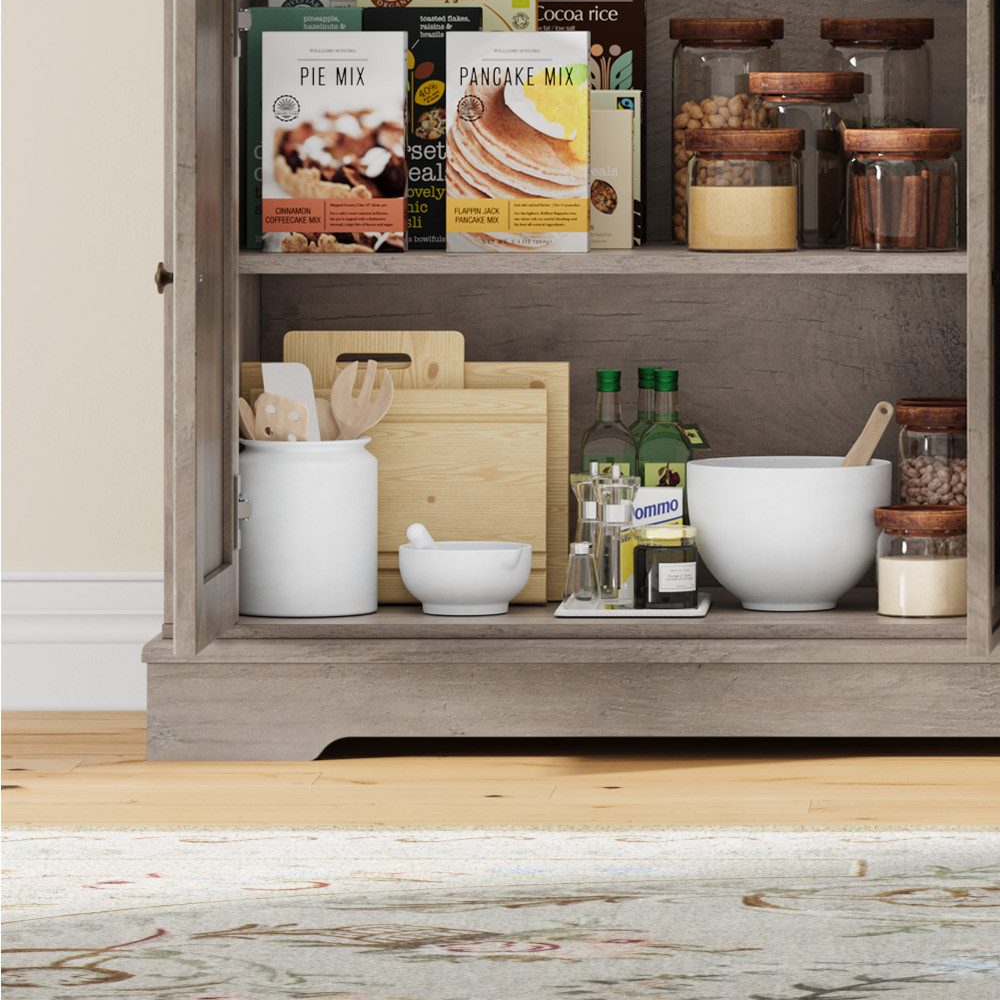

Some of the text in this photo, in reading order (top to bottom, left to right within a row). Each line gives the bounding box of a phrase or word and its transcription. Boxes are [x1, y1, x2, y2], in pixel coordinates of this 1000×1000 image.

[588, 5, 619, 21] rice
[300, 67, 365, 86] PIE MIX
[460, 67, 574, 86] PANCAKE MIX
[408, 163, 446, 182] eal
[275, 206, 311, 214] CINNAMON
[454, 207, 500, 215] FLAPPIN JACK
[265, 216, 307, 224] COFFEECAKE
[308, 216, 321, 224] MIX
[455, 216, 499, 224] PANCAKE MIX
[632, 499, 679, 520] ommo
